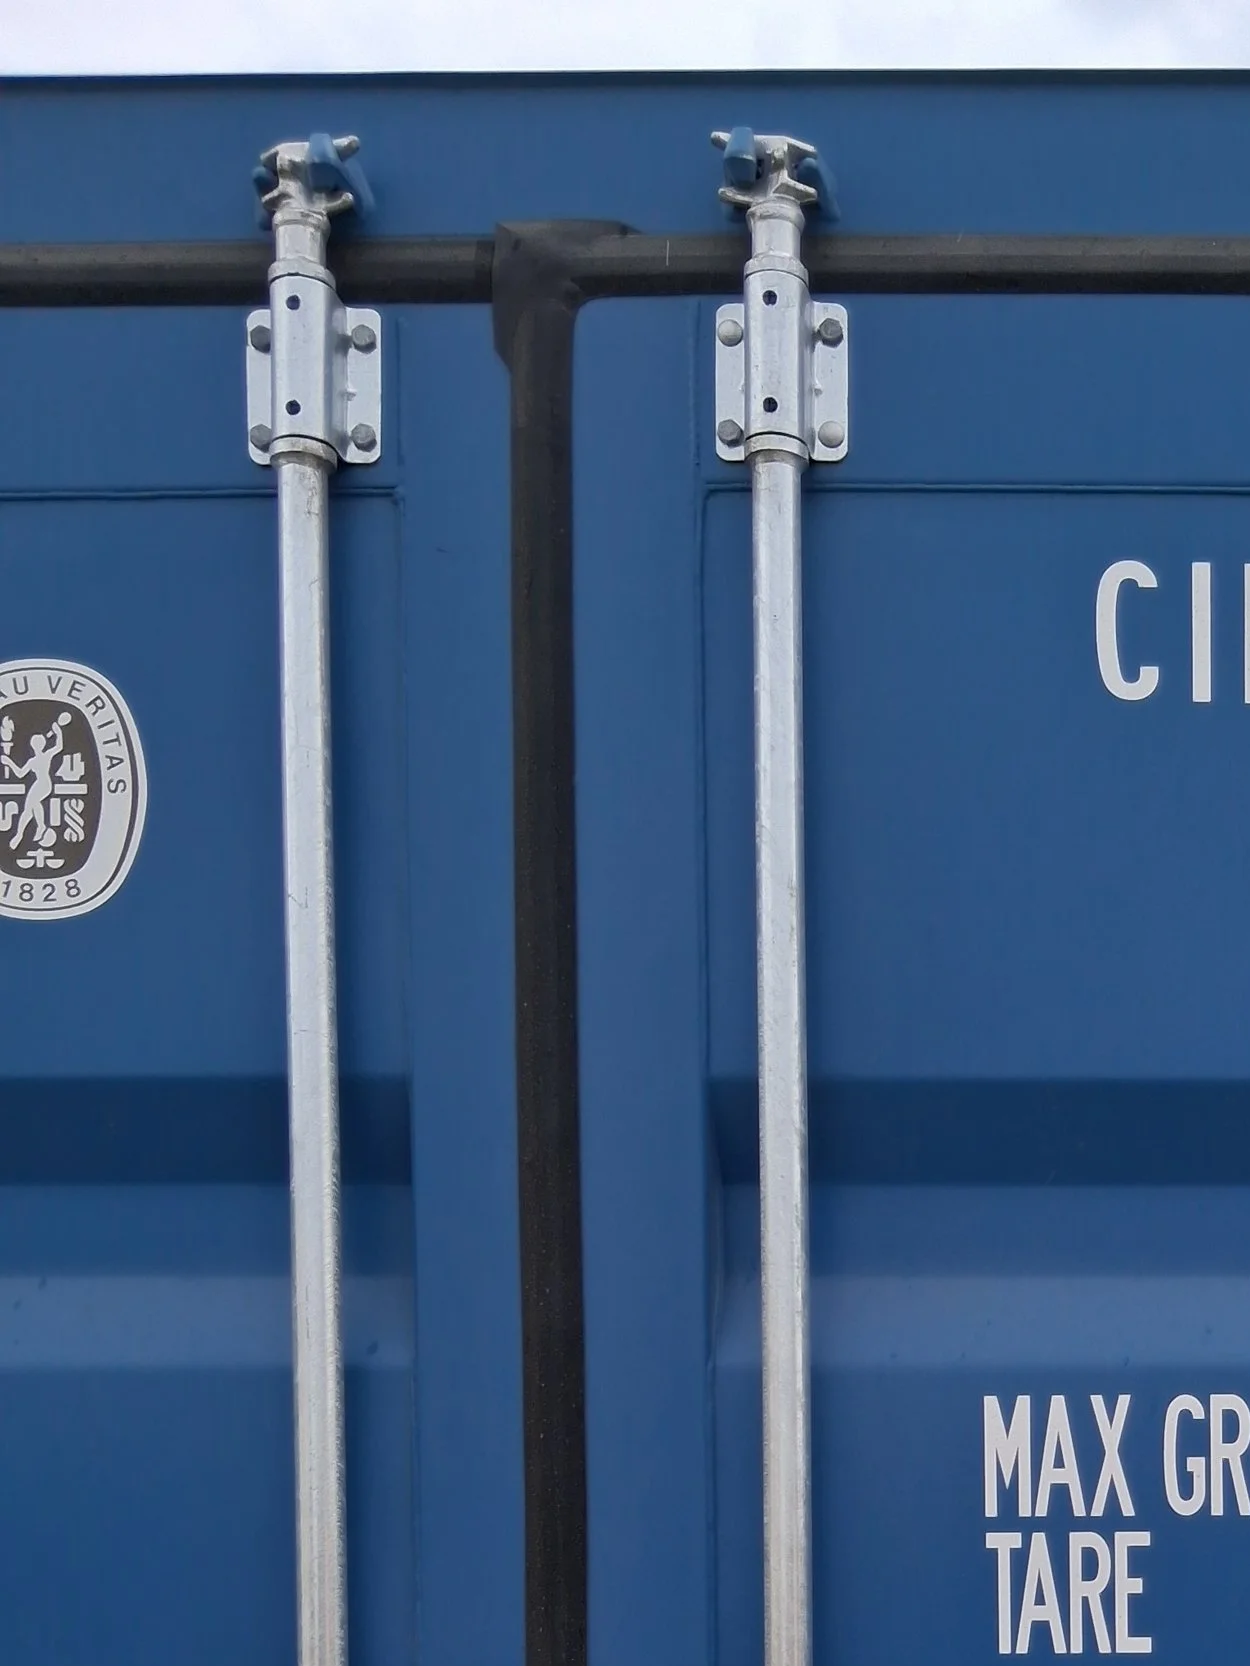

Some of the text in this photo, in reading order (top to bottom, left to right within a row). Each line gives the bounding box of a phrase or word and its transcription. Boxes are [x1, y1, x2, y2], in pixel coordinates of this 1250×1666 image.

[47, 675, 127, 795] VERITAS
[1, 878, 82, 902] 1828
[983, 1394, 1136, 1518] MAX
[985, 1531, 1153, 1655] TARE
